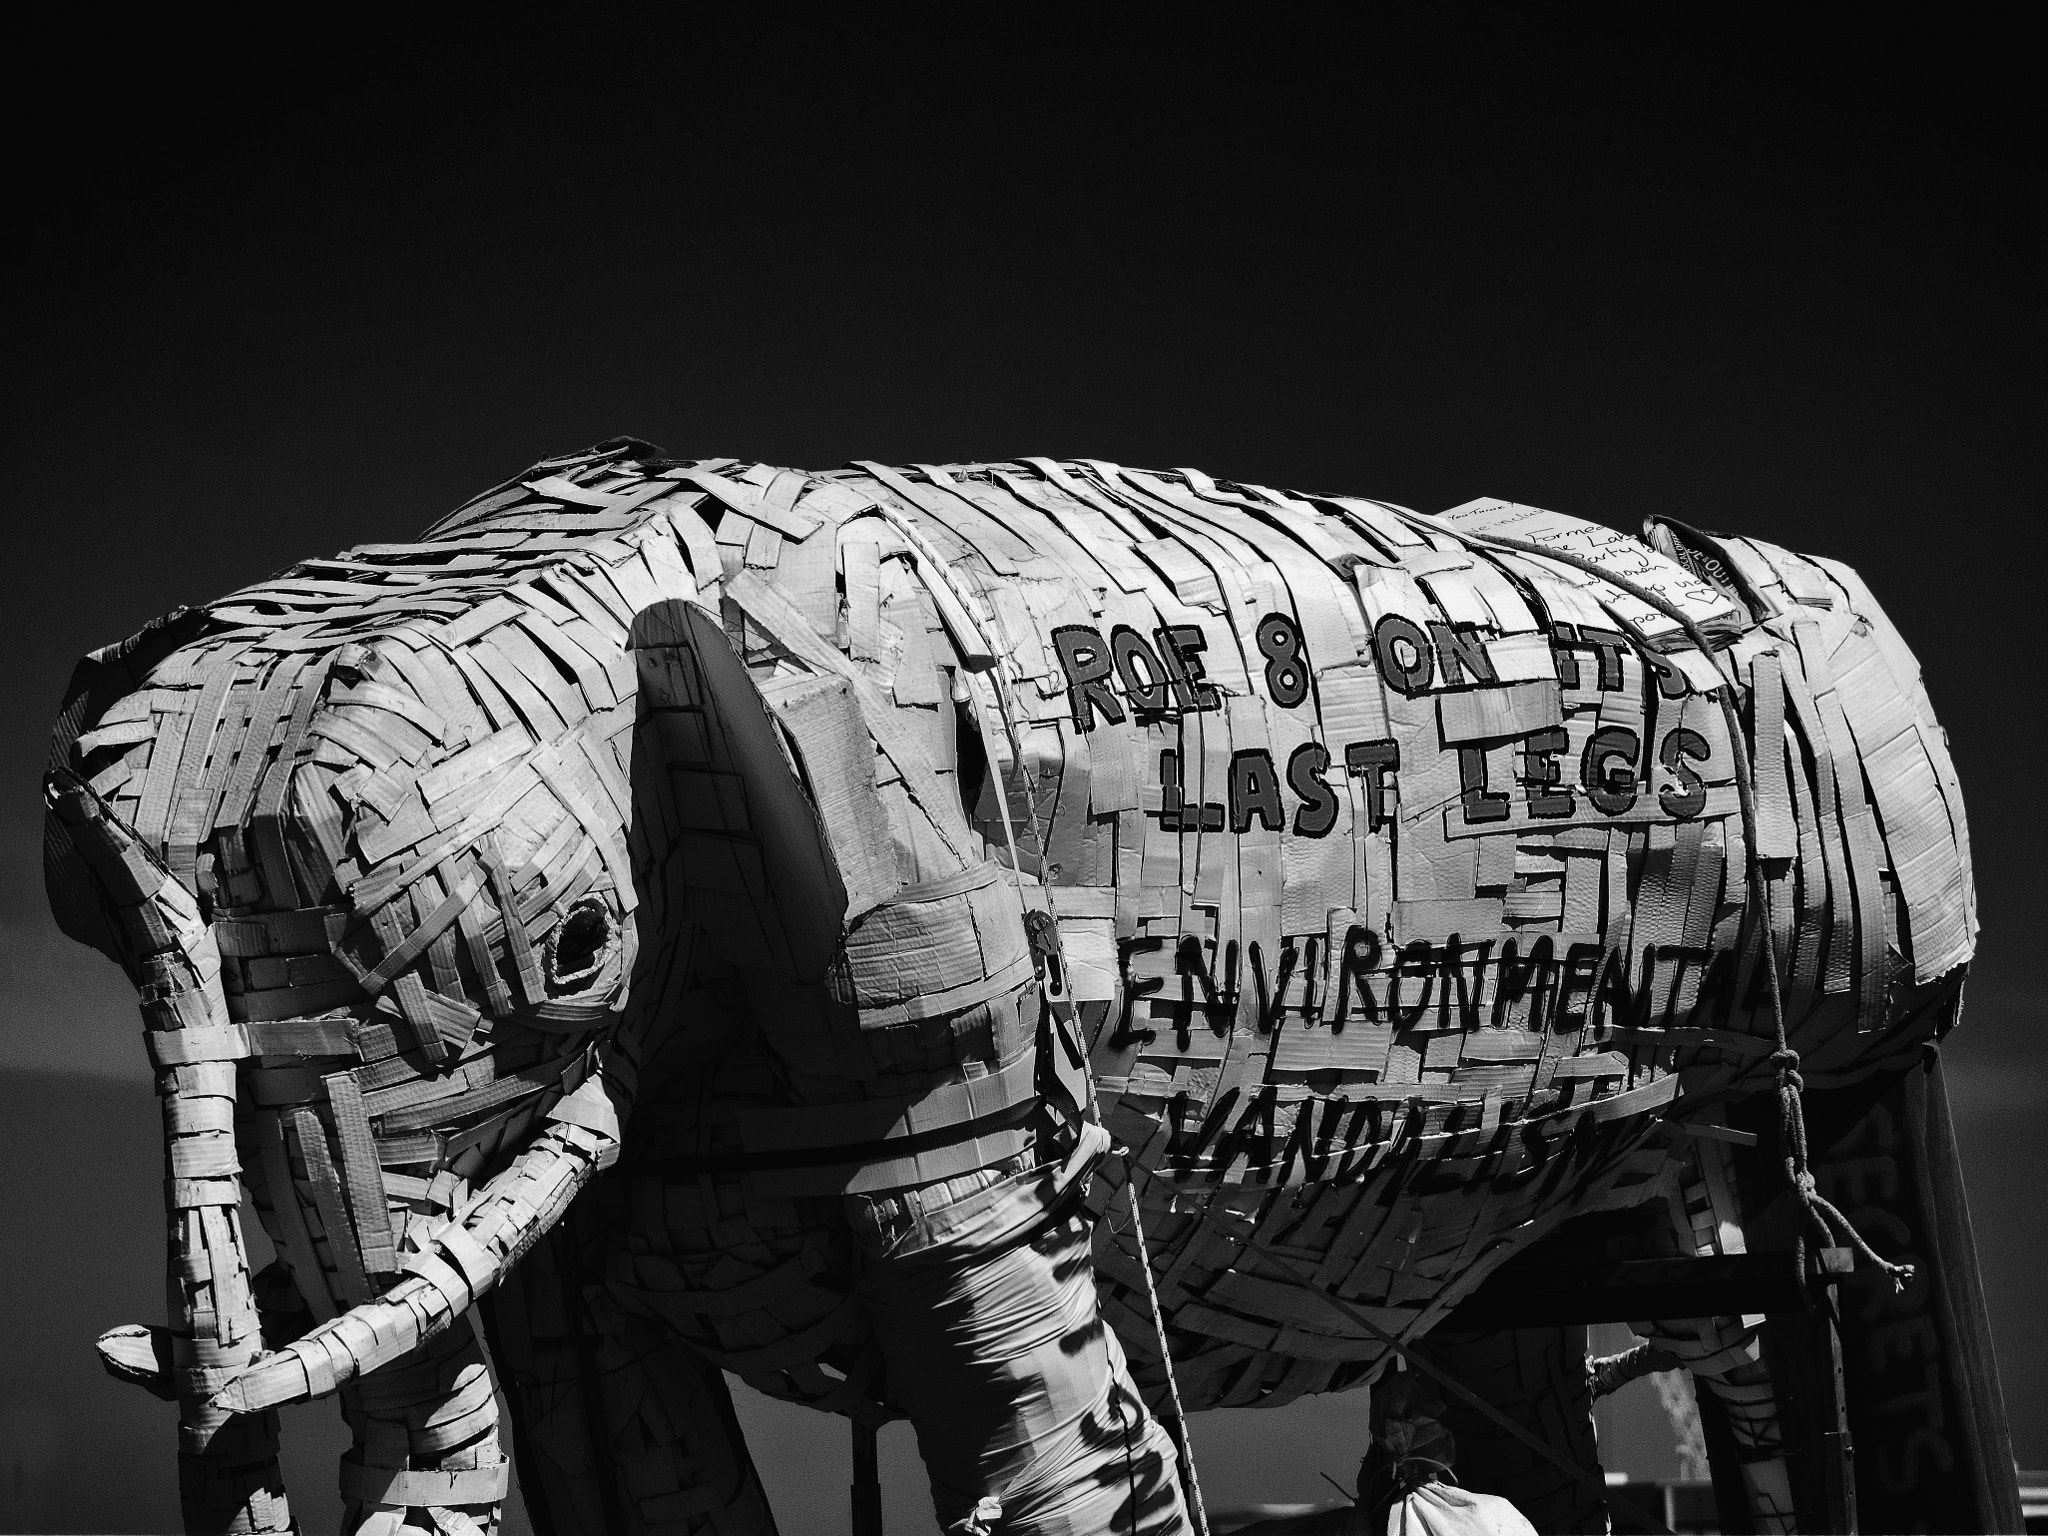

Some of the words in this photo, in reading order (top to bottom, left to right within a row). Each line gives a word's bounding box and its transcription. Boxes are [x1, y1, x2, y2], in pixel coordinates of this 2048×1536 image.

[1051, 623, 1221, 735] ROE
[1256, 611, 1309, 709] 8
[1374, 612, 1500, 700] ON
[1160, 738, 1401, 839] LAST
[1458, 725, 1711, 824] LEGS
[1110, 924, 1791, 1052] ENVIRONMENTAL
[1165, 1075, 1634, 1207] VANDALISM
